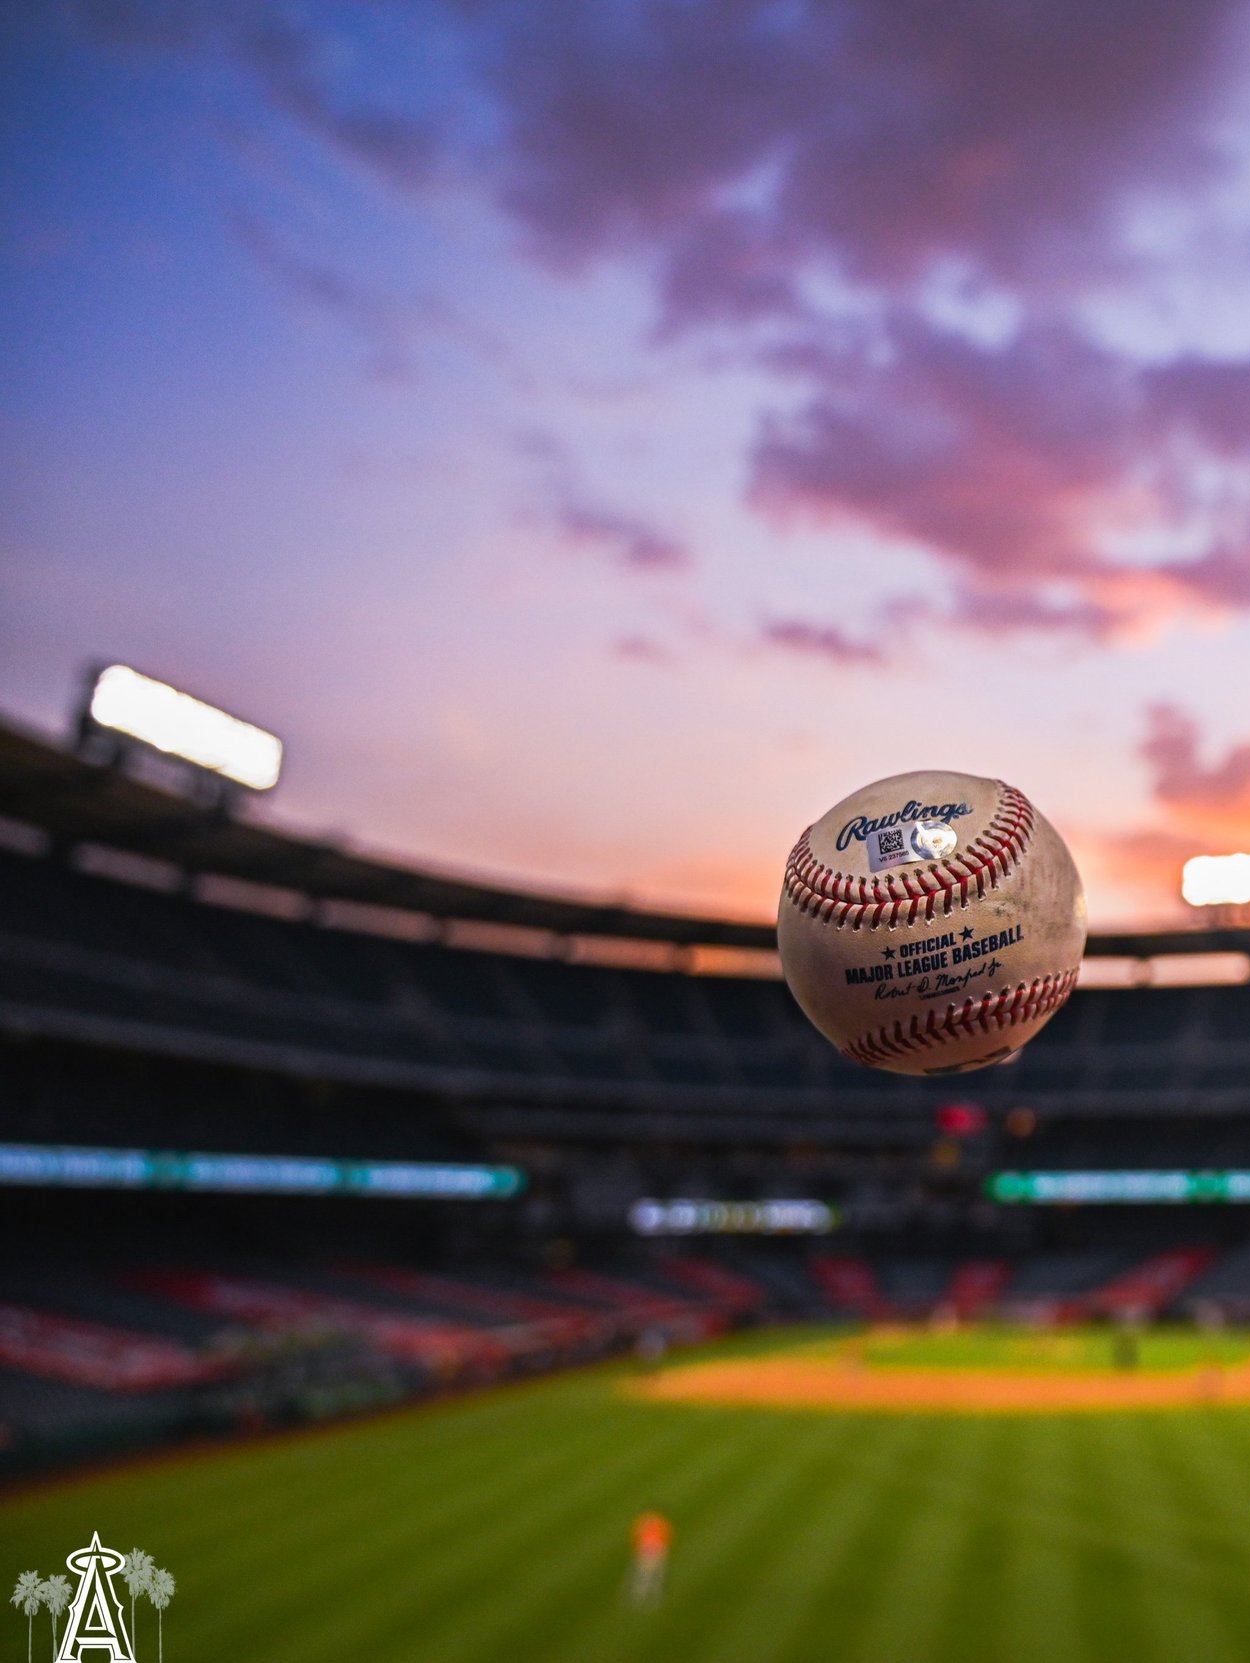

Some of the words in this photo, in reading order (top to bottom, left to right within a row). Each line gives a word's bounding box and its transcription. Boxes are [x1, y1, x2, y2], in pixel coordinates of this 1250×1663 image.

[836, 800, 973, 851] Rawlings
[845, 964, 893, 985] MAJOR
[898, 951, 948, 978] LEAGUE
[952, 925, 1024, 965] BASEBALL
[900, 932, 957, 958] OFFICIAL
